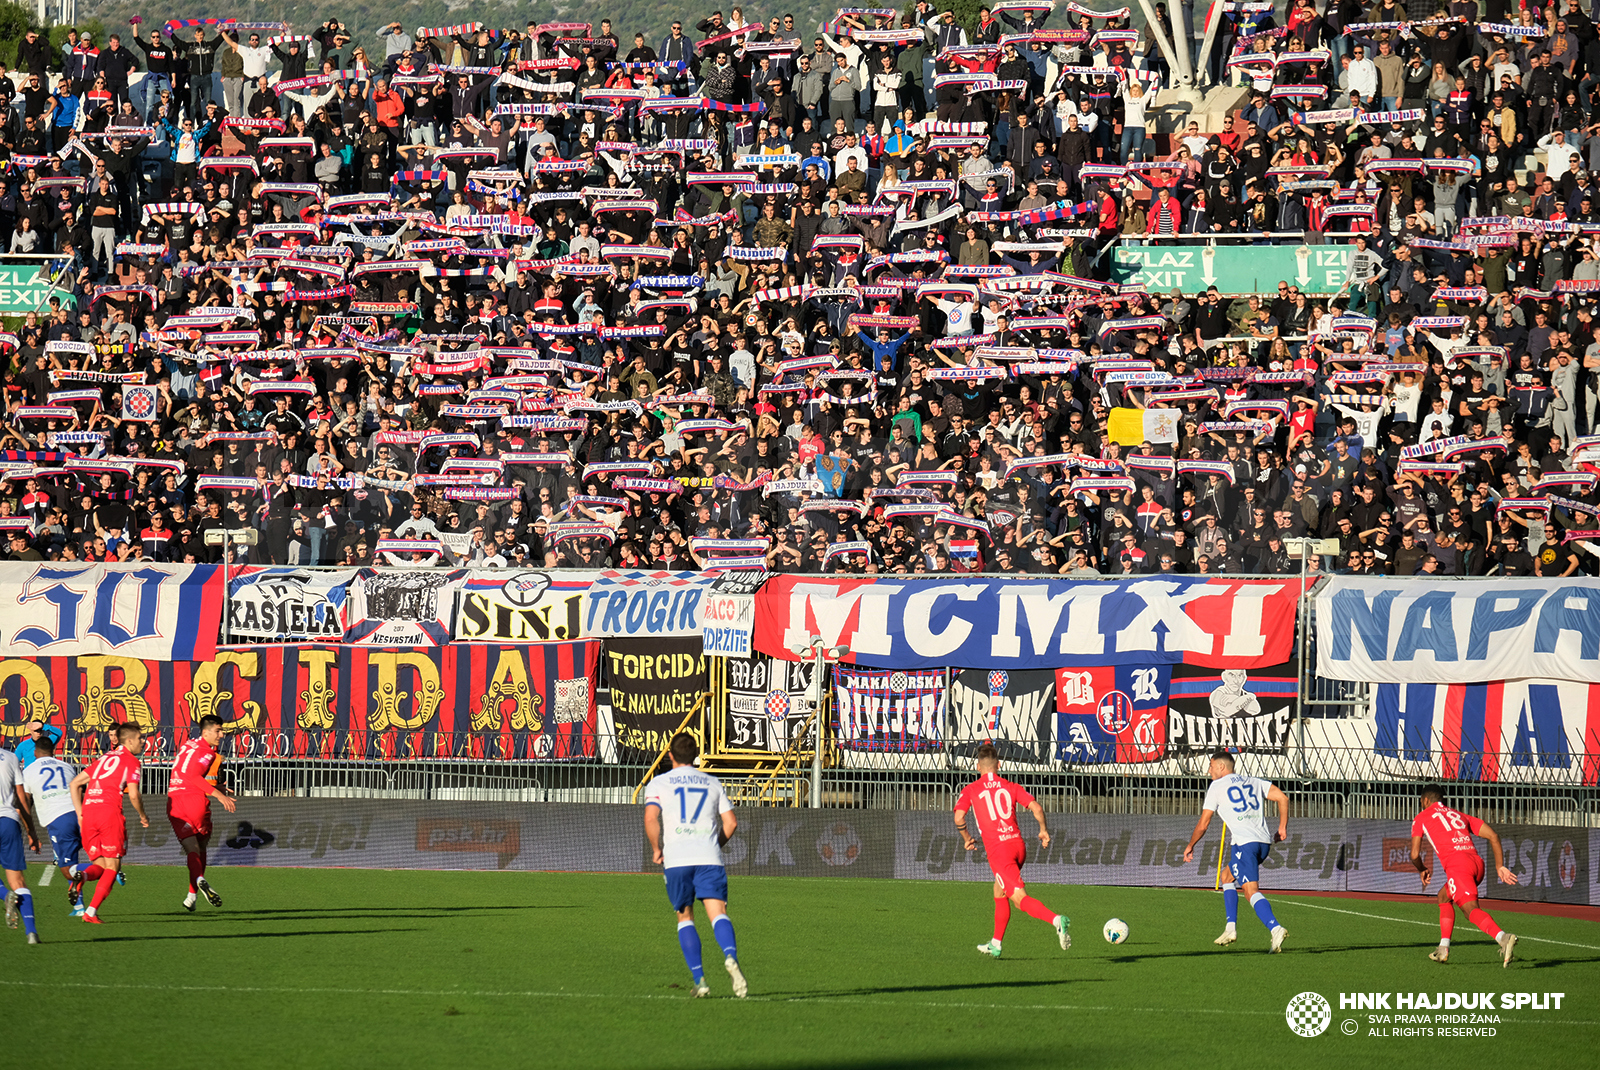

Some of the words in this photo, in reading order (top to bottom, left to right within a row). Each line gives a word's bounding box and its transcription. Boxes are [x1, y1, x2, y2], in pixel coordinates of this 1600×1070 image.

[277, 80, 306, 90] TORCIDA
[1307, 112, 1334, 122] Hajduk
[1336, 110, 1351, 120] Split
[531, 256, 573, 266] HAJDUK
[1130, 271, 1186, 287] EXIT
[150, 332, 190, 340] HAJDUK
[645, 326, 659, 335] 50
[71, 372, 124, 383] HAJDUK
[128, 388, 152, 398] HAJDUK
[129, 409, 151, 418] SPLIT
[452, 489, 471, 498] Hajduk
[10, 563, 178, 651] 50
[462, 592, 583, 640] SINJ
[586, 588, 704, 634] TROGIR
[784, 580, 1285, 658] MCMXI
[371, 632, 424, 644] NESVRSTANI
[609, 651, 706, 680] TORCIDA
[628, 689, 692, 715] NAVIJAČE
[734, 697, 758, 710] WHITE
[92, 756, 120, 780] 19
[40, 766, 68, 791] 21
[674, 787, 709, 824] 17
[978, 788, 1012, 820] 10
[1227, 784, 1260, 812] 93
[1432, 811, 1466, 832] 18
